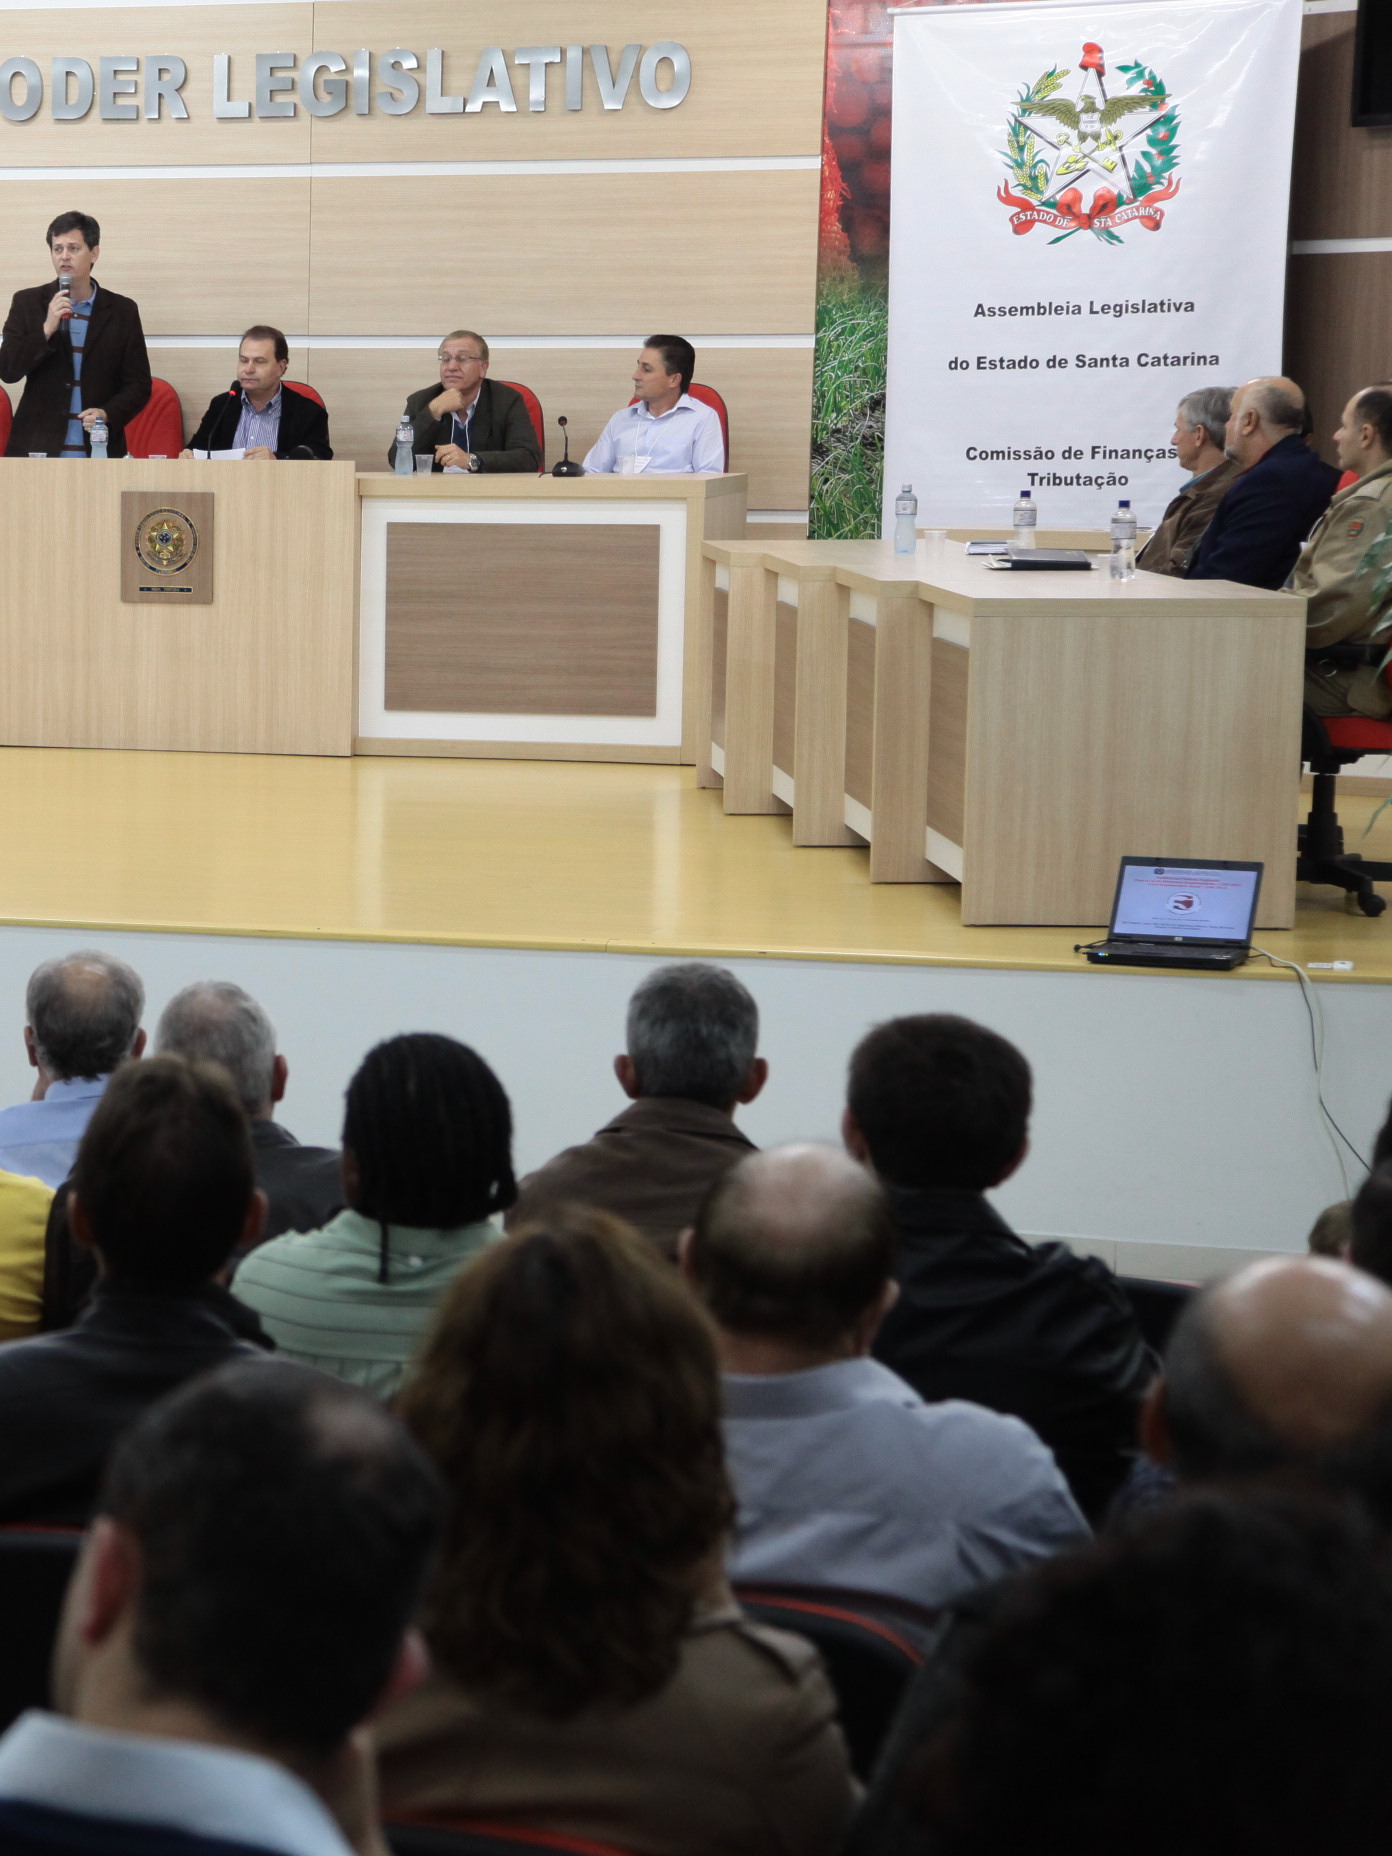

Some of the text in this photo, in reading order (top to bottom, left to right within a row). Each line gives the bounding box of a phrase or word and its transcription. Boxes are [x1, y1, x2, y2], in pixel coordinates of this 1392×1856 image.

[212, 41, 693, 118] LEGISLATIVO
[1013, 210, 1055, 225] ESTADO
[1053, 216, 1071, 228] DE
[1115, 206, 1161, 223] CATARINA
[973, 299, 1195, 318] Assembleia Legislativa
[948, 352, 1220, 371] do Estado de Santa Catarina
[965, 445, 1178, 463] Comissão de Finanças
[1027, 472, 1129, 490] Tributação
